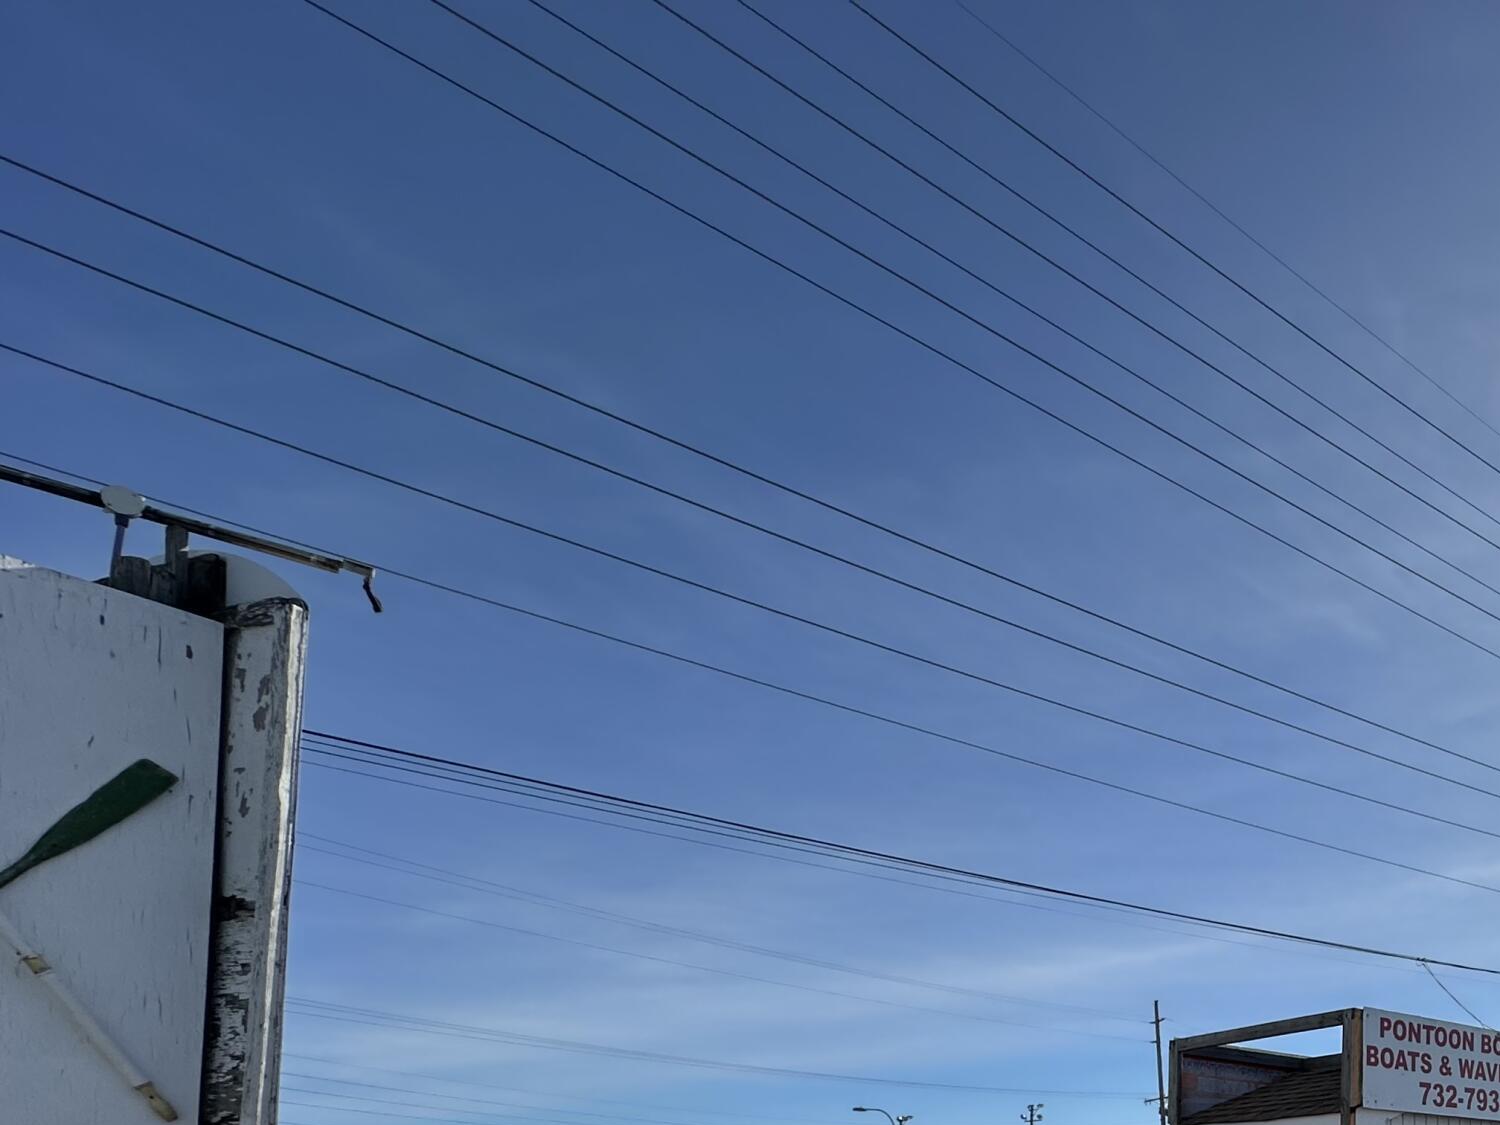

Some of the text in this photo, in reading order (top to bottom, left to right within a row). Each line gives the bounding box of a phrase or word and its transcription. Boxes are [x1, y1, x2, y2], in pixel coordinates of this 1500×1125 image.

[1379, 1017, 1474, 1051] PONTOON
[1366, 1045, 1432, 1074] BOATS
[1439, 1055, 1452, 1077] &
